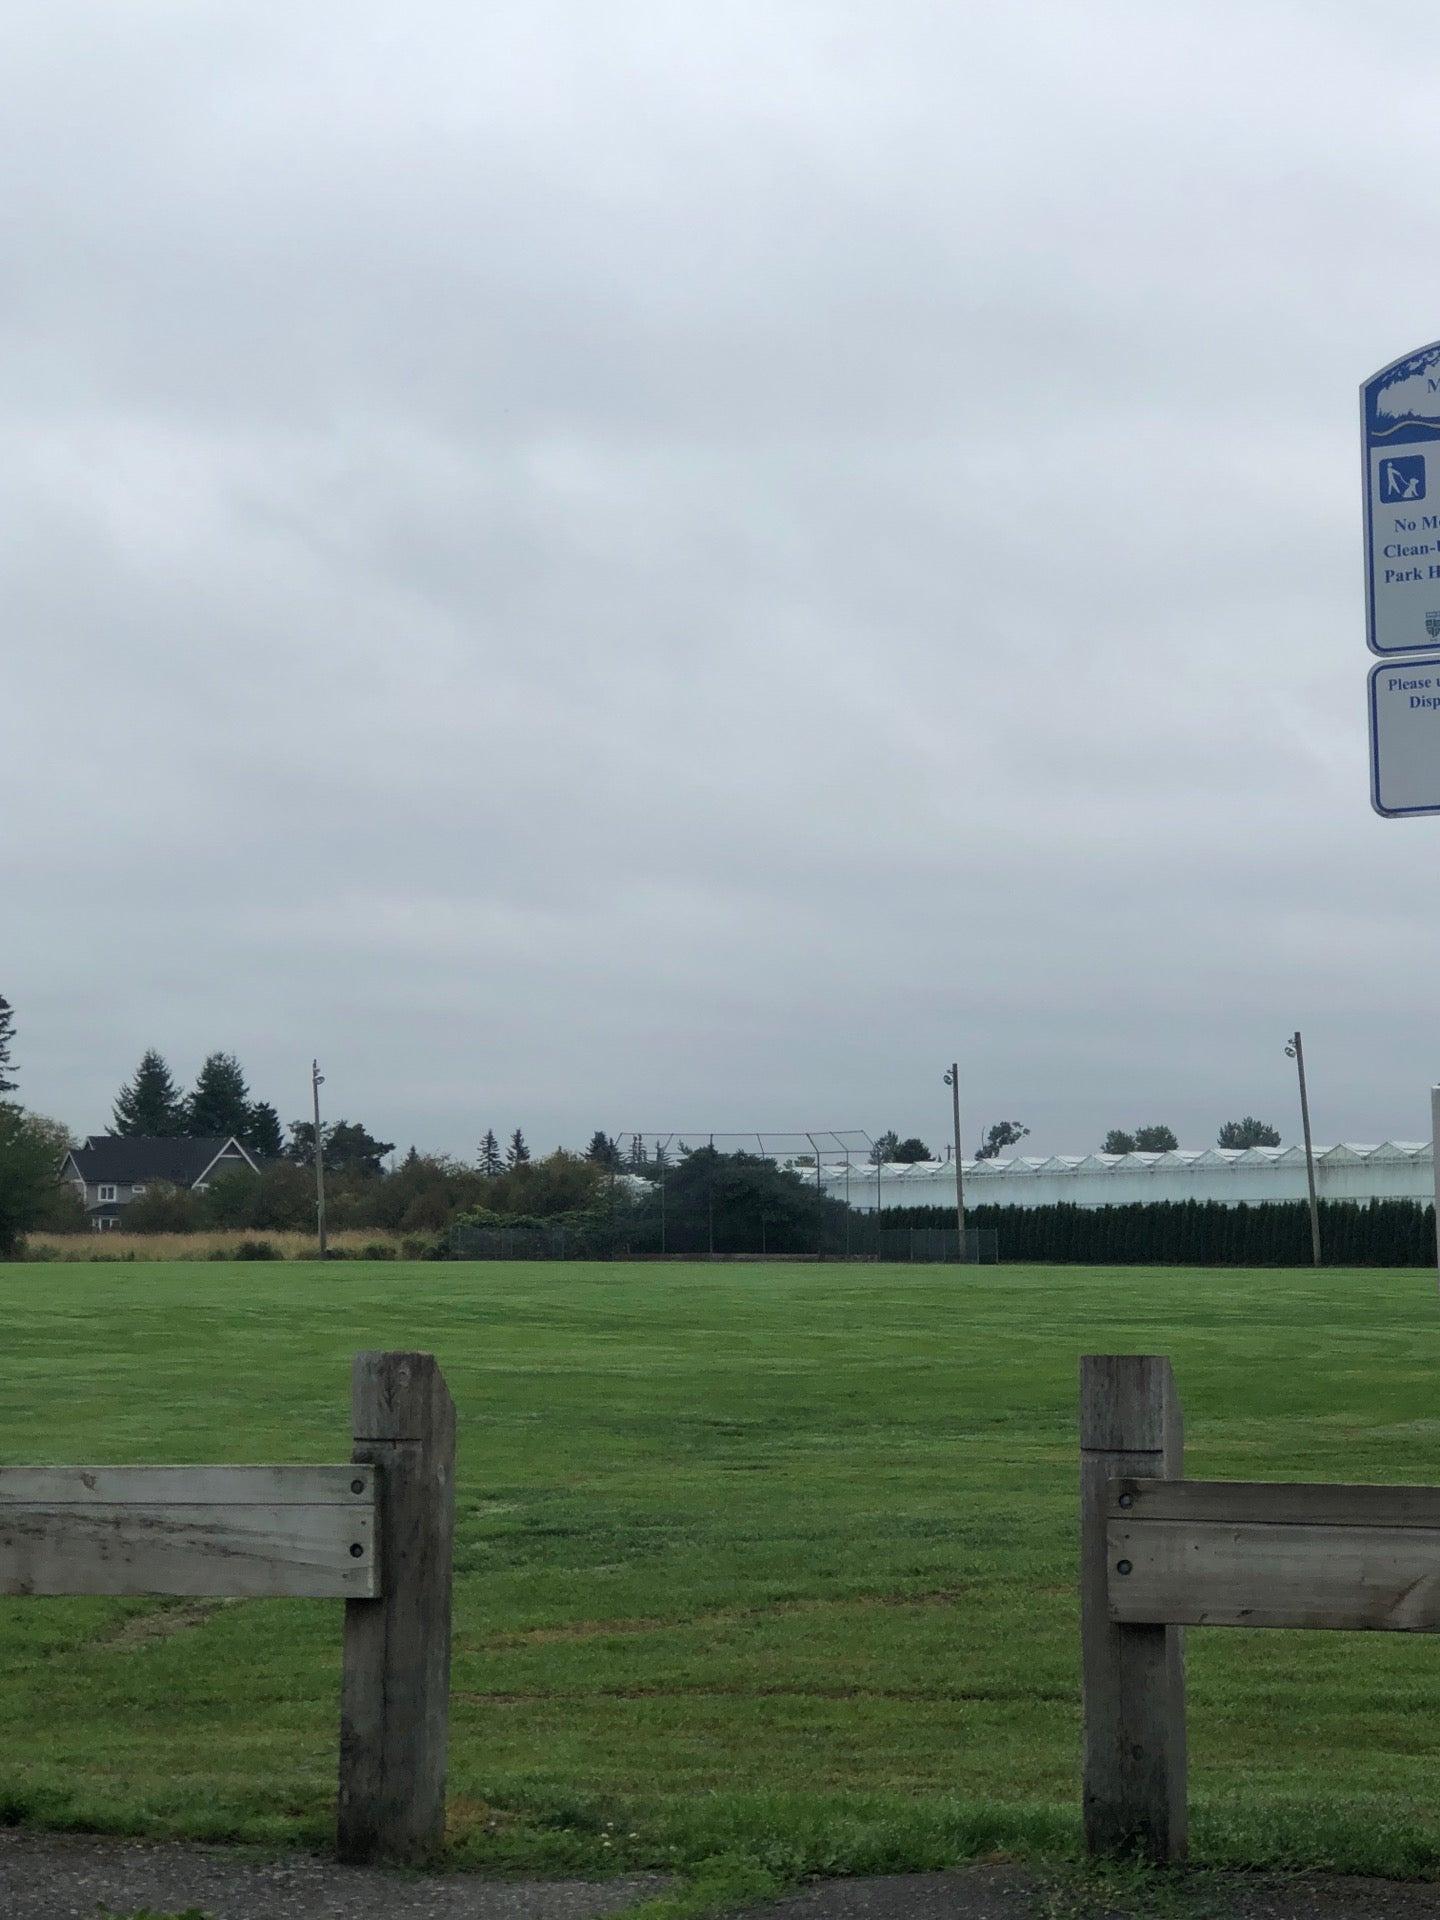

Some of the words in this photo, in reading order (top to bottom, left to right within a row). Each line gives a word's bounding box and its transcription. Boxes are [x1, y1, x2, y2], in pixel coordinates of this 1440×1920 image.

[1394, 518, 1416, 533] No
[1422, 515, 1440, 530] M
[1383, 540, 1440, 558] Clean-
[1384, 566, 1424, 583] Park
[1388, 678, 1431, 691] Please
